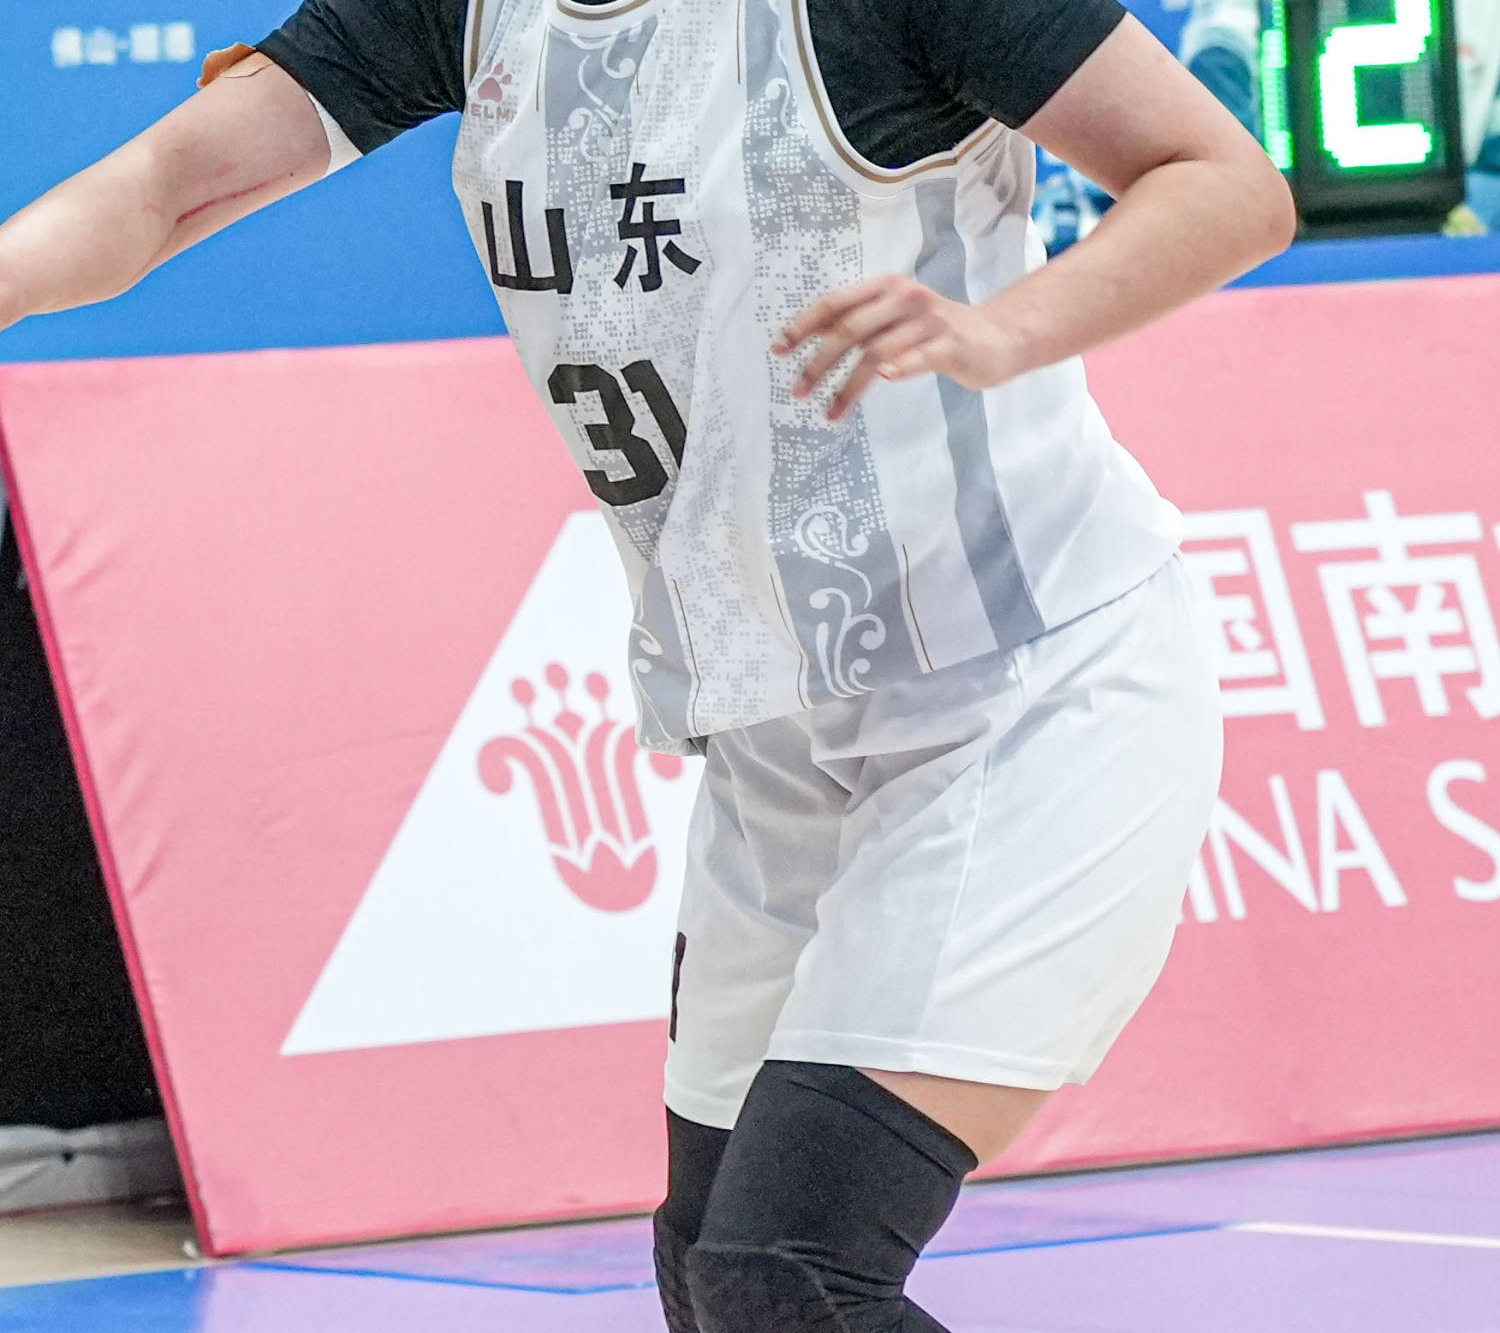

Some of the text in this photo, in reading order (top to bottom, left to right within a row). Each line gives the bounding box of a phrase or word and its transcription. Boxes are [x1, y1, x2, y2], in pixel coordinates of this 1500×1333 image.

[481, 162, 702, 294] 山东
[547, 359, 688, 507] 31
[1177, 770, 1408, 925] INA
